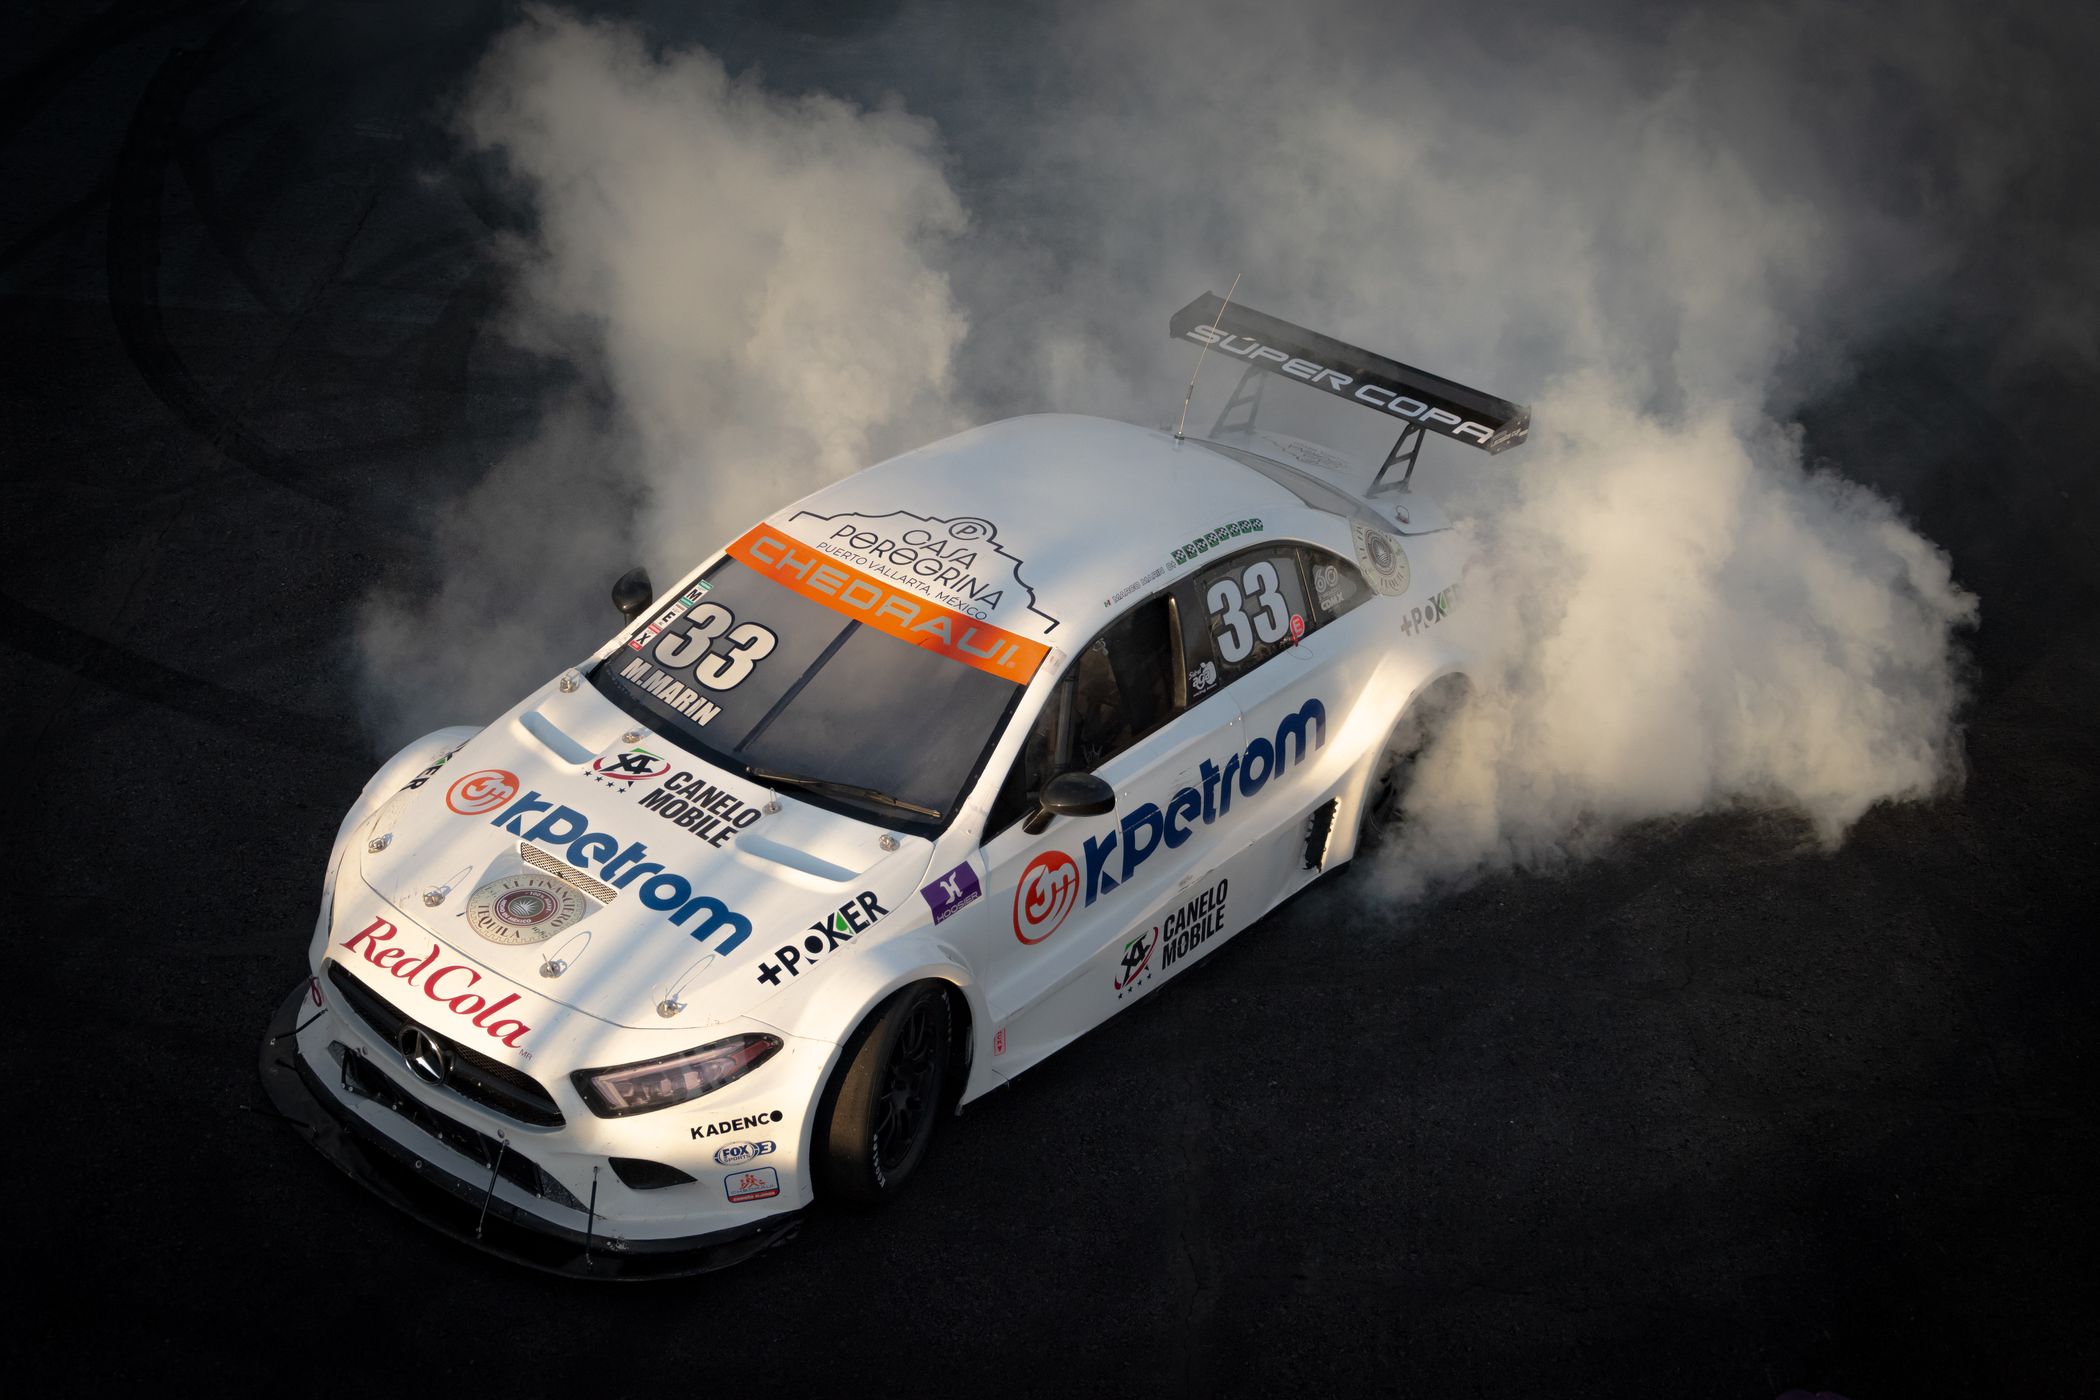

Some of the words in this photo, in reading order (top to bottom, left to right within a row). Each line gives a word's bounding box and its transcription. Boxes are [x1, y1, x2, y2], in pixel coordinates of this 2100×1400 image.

[1187, 324, 1353, 391] SÚPER
[1355, 384, 1495, 444] COPA
[816, 541, 867, 566] PUERTO
[868, 561, 930, 595] VALLARTA,
[935, 591, 987, 620] MÉXICO
[830, 524, 1003, 610] PEREGRINA
[902, 529, 978, 570] CASA
[748, 536, 1019, 666] CHEDRAUI
[1206, 561, 1290, 663] 33
[652, 601, 779, 692] 33
[620, 657, 723, 727] M.MARIN
[638, 788, 739, 849] MOBILE
[663, 771, 762, 830] CANELO
[478, 904, 521, 939] TEQUILA
[757, 890, 890, 986] +POKER
[937, 890, 979, 923] HOOSIER
[1161, 904, 1226, 971] MOBILE
[1163, 878, 1228, 943] CANELO
[339, 916, 440, 987] Red
[424, 965, 531, 1049] Cola
[690, 1110, 783, 1140] KADENCO
[722, 1144, 750, 1157] FOX
